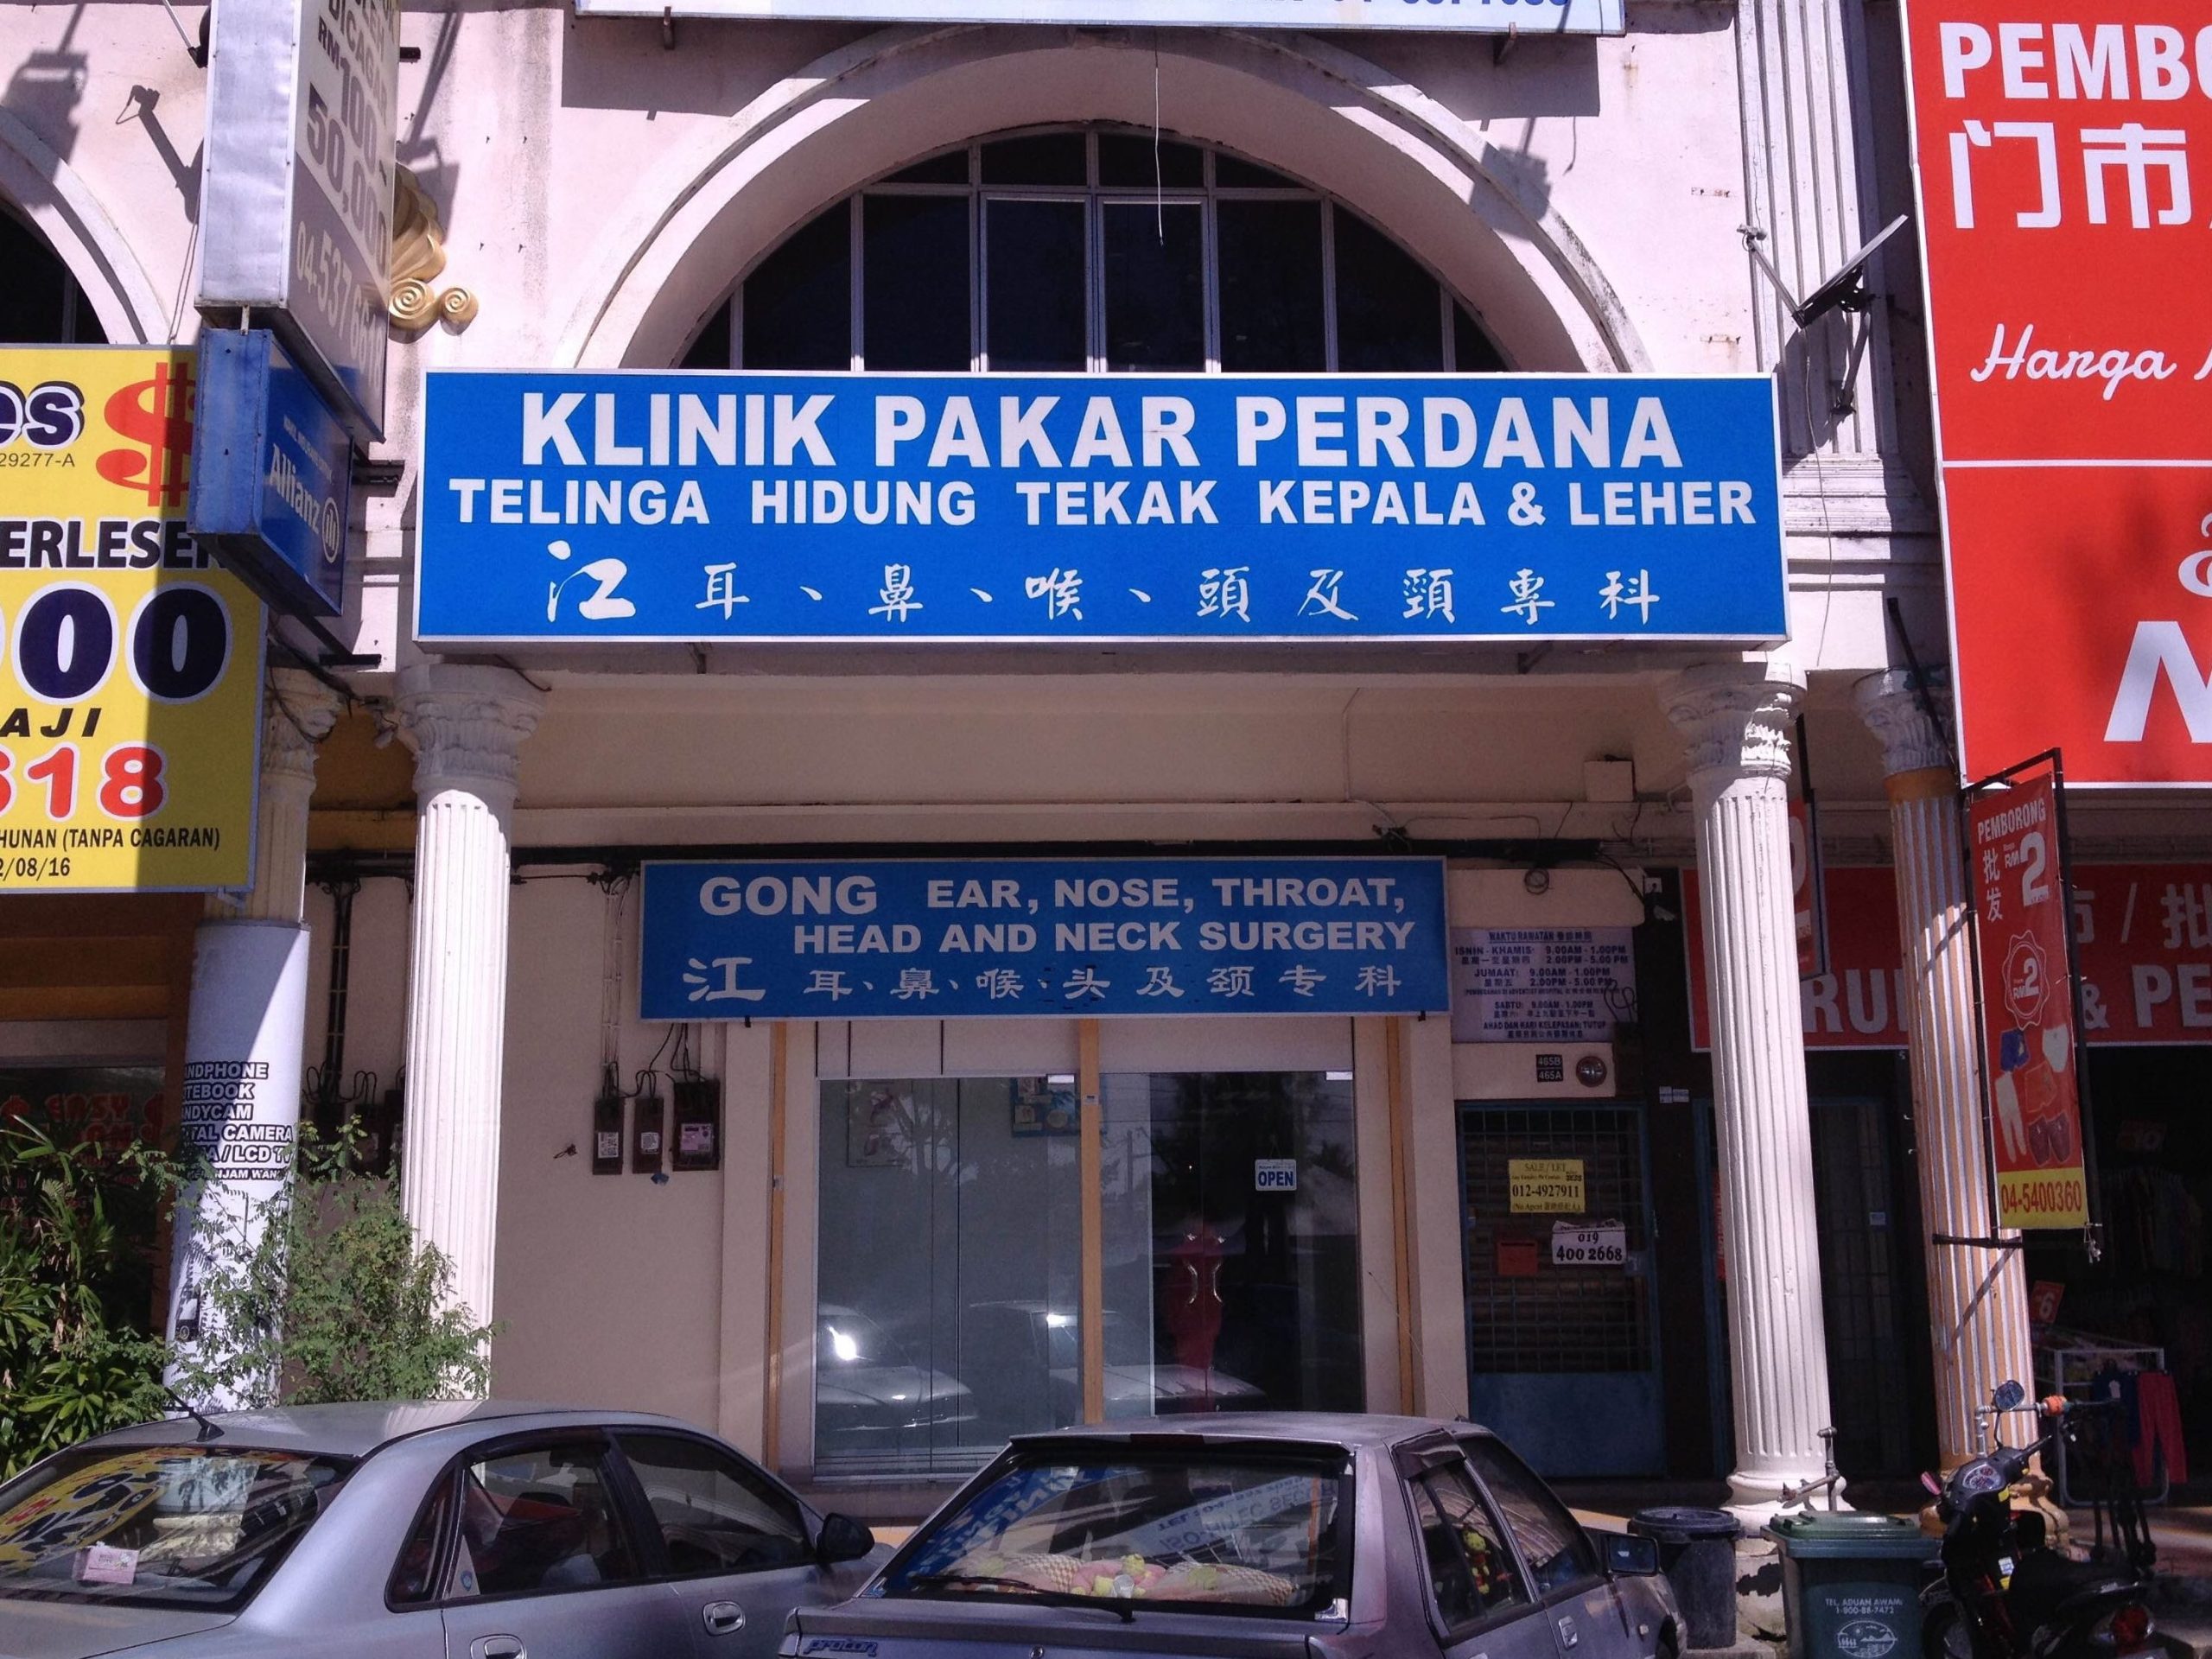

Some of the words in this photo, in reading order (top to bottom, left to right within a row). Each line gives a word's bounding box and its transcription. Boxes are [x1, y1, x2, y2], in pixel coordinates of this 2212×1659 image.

[1969, 323, 2177, 401] Harga
[523, 392, 836, 467] KLINIK
[874, 395, 1200, 467] PAKAR
[1236, 396, 1682, 468] PERDANA
[270, 442, 321, 536] Allianz
[449, 478, 710, 525] TELINGA
[752, 480, 976, 526] HIDUNG
[1016, 480, 1219, 526] TEKAK
[1259, 480, 1486, 526] KEPALA
[1508, 484, 1546, 527] &
[1569, 481, 1756, 526] LEHER
[0, 746, 165, 819] 18
[1977, 798, 2047, 844] PEMBORONG
[62, 829, 124, 852] (TANPA
[130, 827, 220, 851] CAGARAN)
[1982, 847, 2003, 924] 批发
[699, 875, 877, 917] GONG
[927, 879, 1039, 916] EAR,
[1054, 878, 1194, 915] NOSE,
[1212, 877, 1407, 915] THROAT,
[794, 925, 922, 954] HEAD
[939, 924, 1037, 954] AND
[1055, 922, 1182, 951] NECK
[1199, 920, 1416, 951] SURGERY
[185, 1062, 269, 1080] NDPHONE
[1537, 1057, 1561, 1066] 465B
[1538, 1071, 1562, 1080] 465A
[183, 1083, 256, 1100] TEBOOK
[182, 1103, 254, 1122] NDYCAM
[222, 1124, 294, 1143] CAMERA
[233, 1145, 271, 1163] LCD
[251, 1168, 286, 1181] WAN
[1258, 1170, 1294, 1187] OPEN
[1512, 1184, 1579, 1198] 012-4927911
[2000, 1180, 2082, 1213] 04-5400360
[1578, 1230, 1599, 1244] 019
[1556, 1245, 1585, 1262] 400
[1588, 1245, 1623, 1262] 2668
